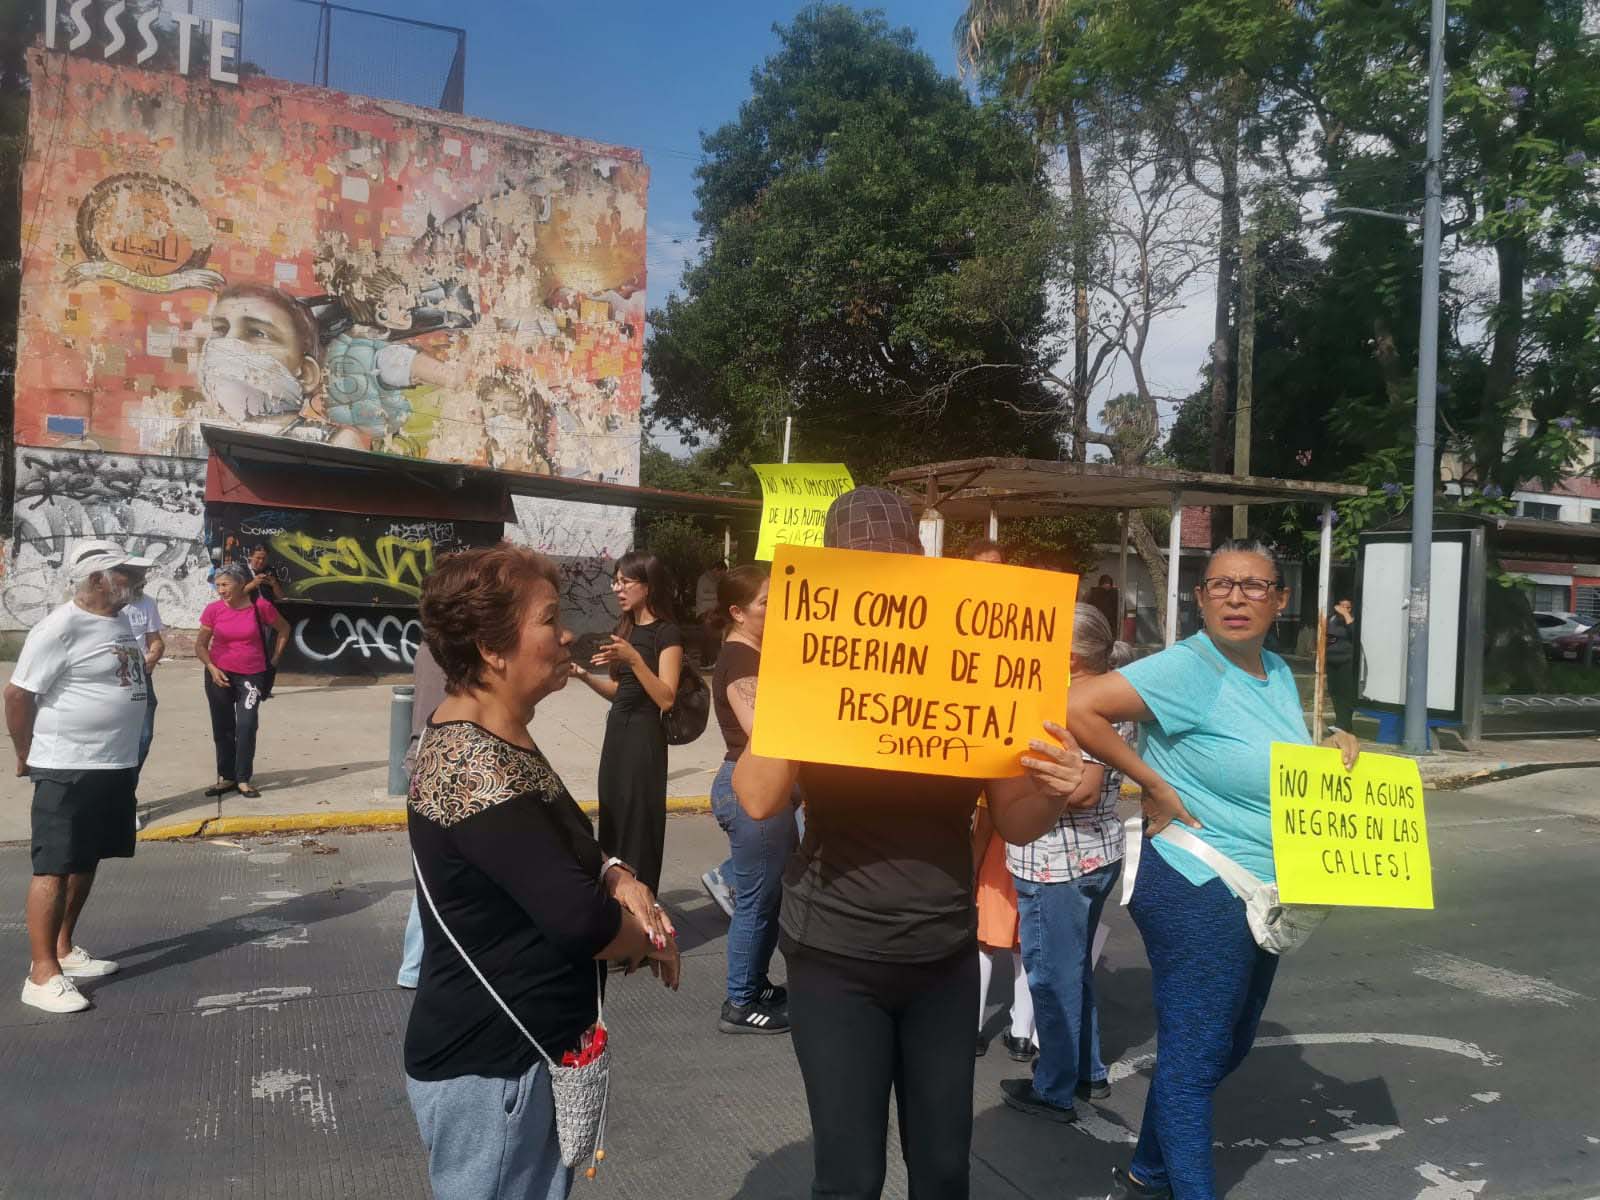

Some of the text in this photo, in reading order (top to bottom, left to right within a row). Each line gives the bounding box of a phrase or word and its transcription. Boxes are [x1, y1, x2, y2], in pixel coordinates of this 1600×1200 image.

[45, 0, 240, 84] ISSSTE
[781, 477, 802, 495] MAS
[803, 478, 852, 497] OMISIONES
[768, 507, 780, 524] DE
[783, 506, 799, 527] LAS
[854, 590, 927, 630] COMO
[955, 598, 1057, 643] COBRAN
[802, 632, 1042, 691] DEBERIAN DE DAR
[837, 687, 1017, 746] RESPUESTA!
[876, 734, 984, 762] SIAPA
[1321, 773, 1353, 803] MAS
[1365, 781, 1415, 809] AGUAS
[1285, 808, 1419, 843] NEGRAS EN LAS
[1322, 849, 1411, 881] CALLES!
